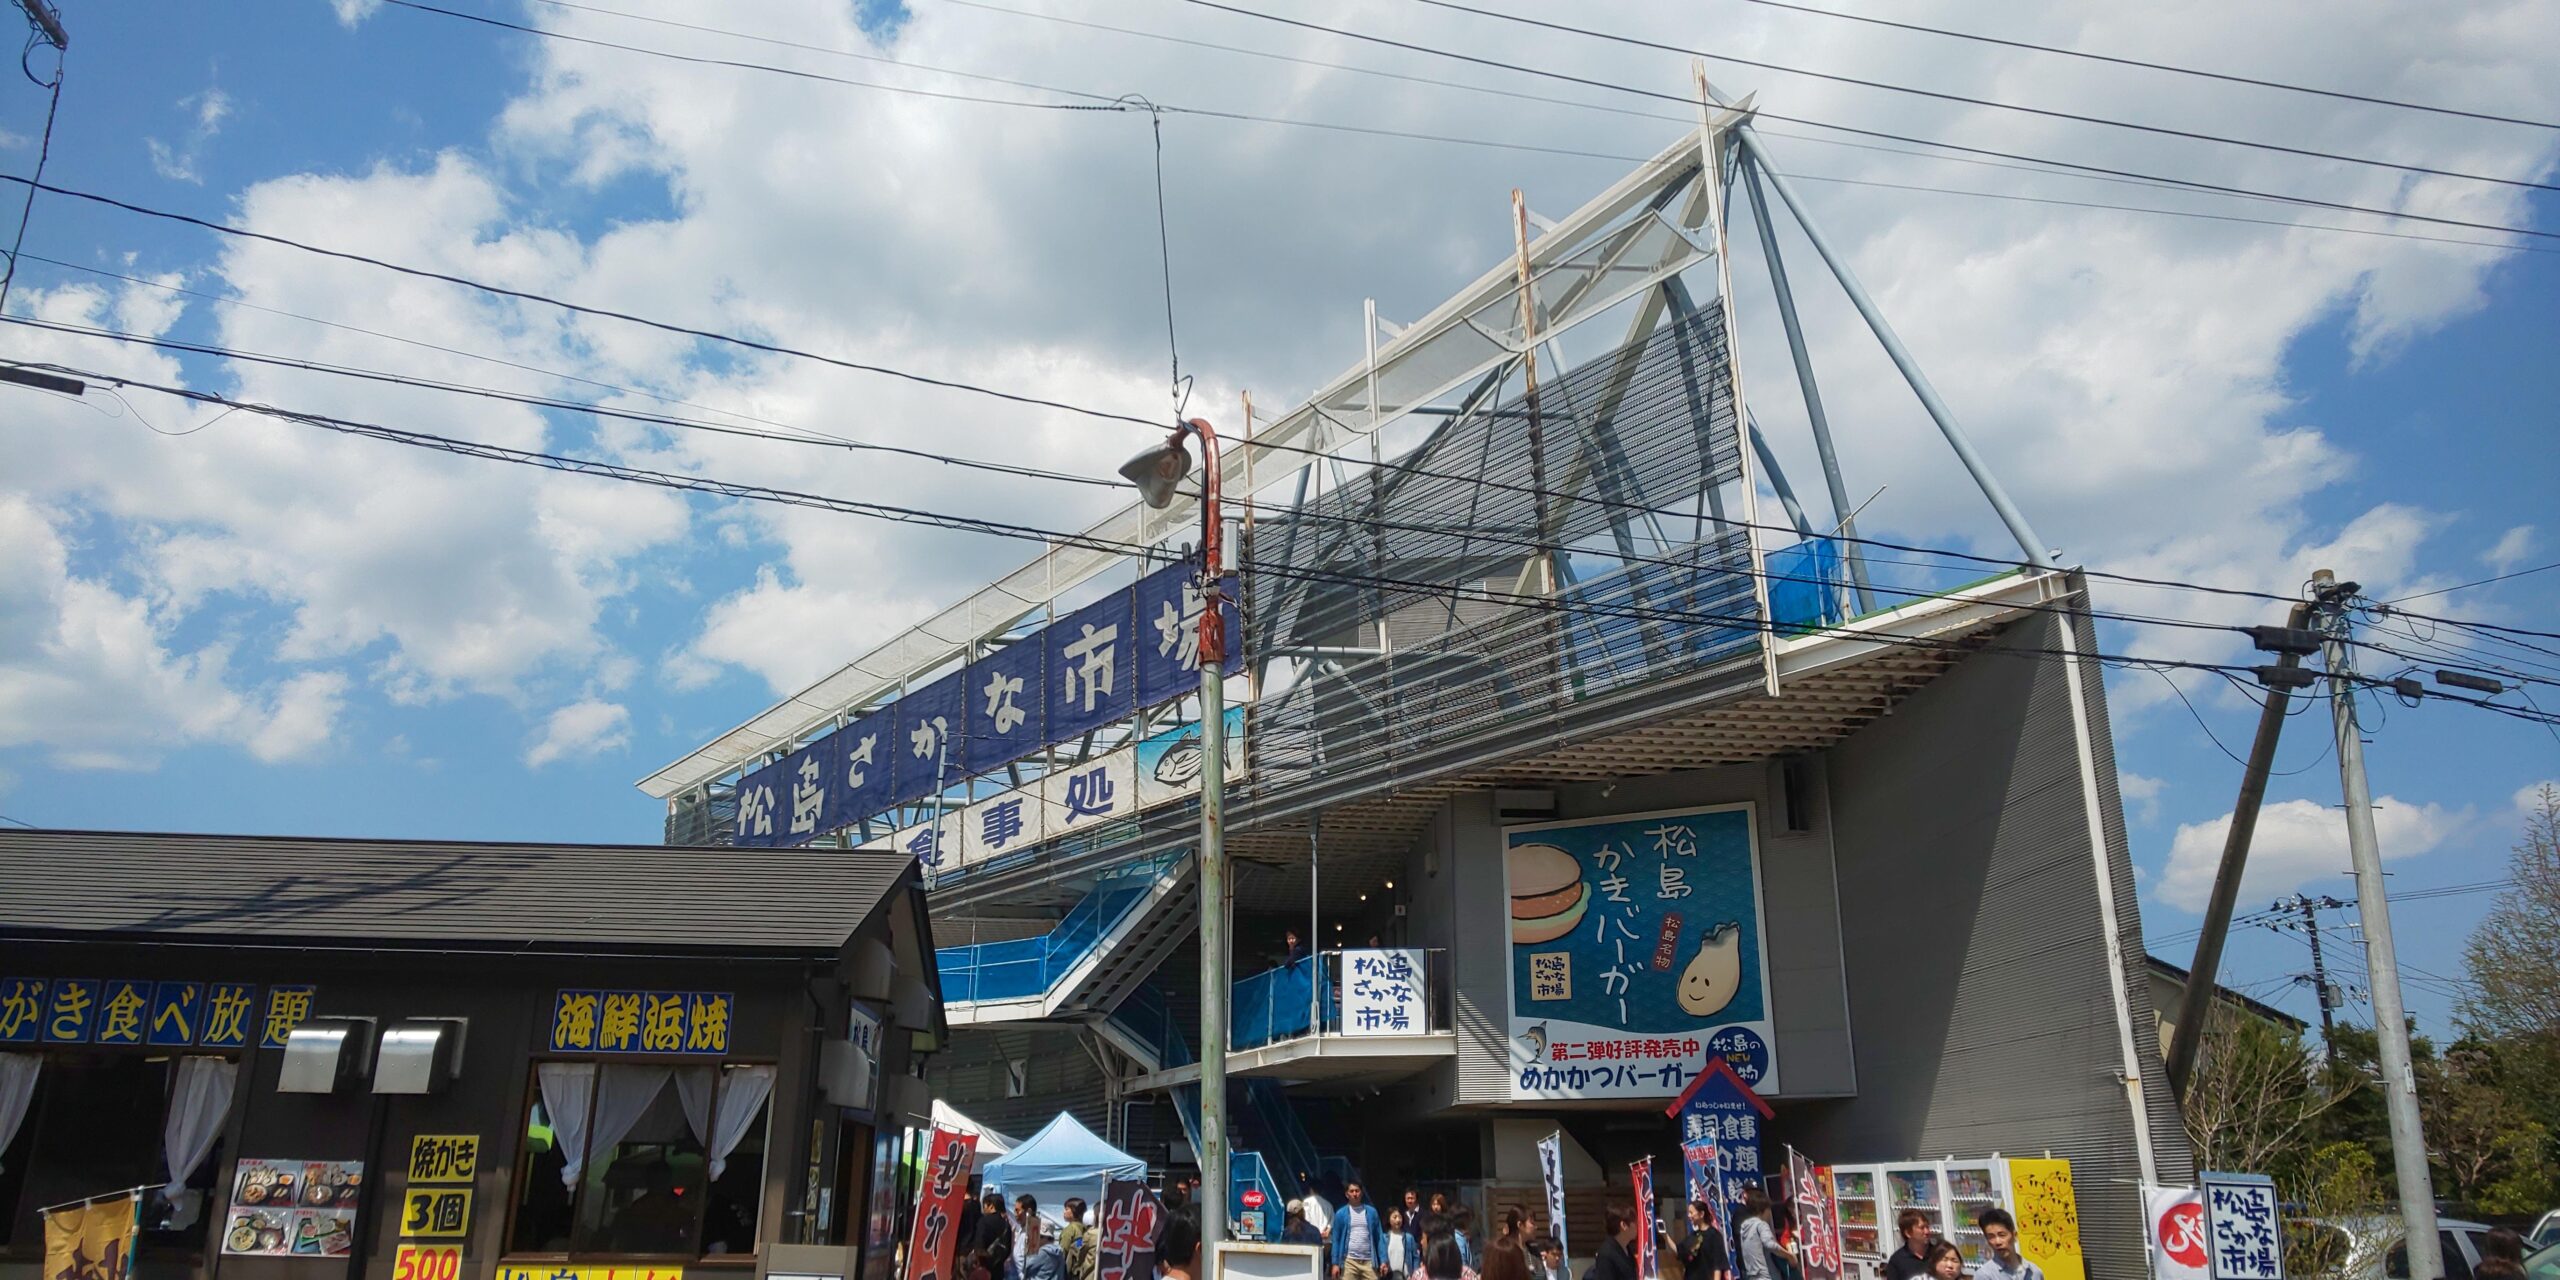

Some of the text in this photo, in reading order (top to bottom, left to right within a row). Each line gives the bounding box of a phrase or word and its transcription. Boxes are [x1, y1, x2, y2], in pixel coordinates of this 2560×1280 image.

[736, 582, 1222, 837] 松島さかな市場
[906, 766, 1115, 867] 食事処
[1644, 823, 1697, 900] 松島
[1593, 841, 1644, 1025] かきバーガー
[1655, 915, 1681, 969] 松島名物
[1354, 952, 1412, 982] 松島
[1536, 956, 1566, 971] 松島
[1353, 979, 1412, 1003] さかな
[1537, 983, 1565, 997] 市場
[554, 993, 729, 1051] 海鮮浜焼
[1355, 1005, 1410, 1031] 市場
[1551, 1037, 1700, 1063] 第二弾好評発売中
[1712, 1033, 1761, 1052] 松島の
[1726, 1053, 1751, 1063] NEW
[412, 1138, 475, 1179] 焼がき
[407, 1193, 466, 1233] 3個
[2212, 1187, 2271, 1225] 松島
[2215, 1219, 2275, 1248] さかな
[395, 1248, 458, 1280] 500
[2220, 1244, 2277, 1279] 市場
